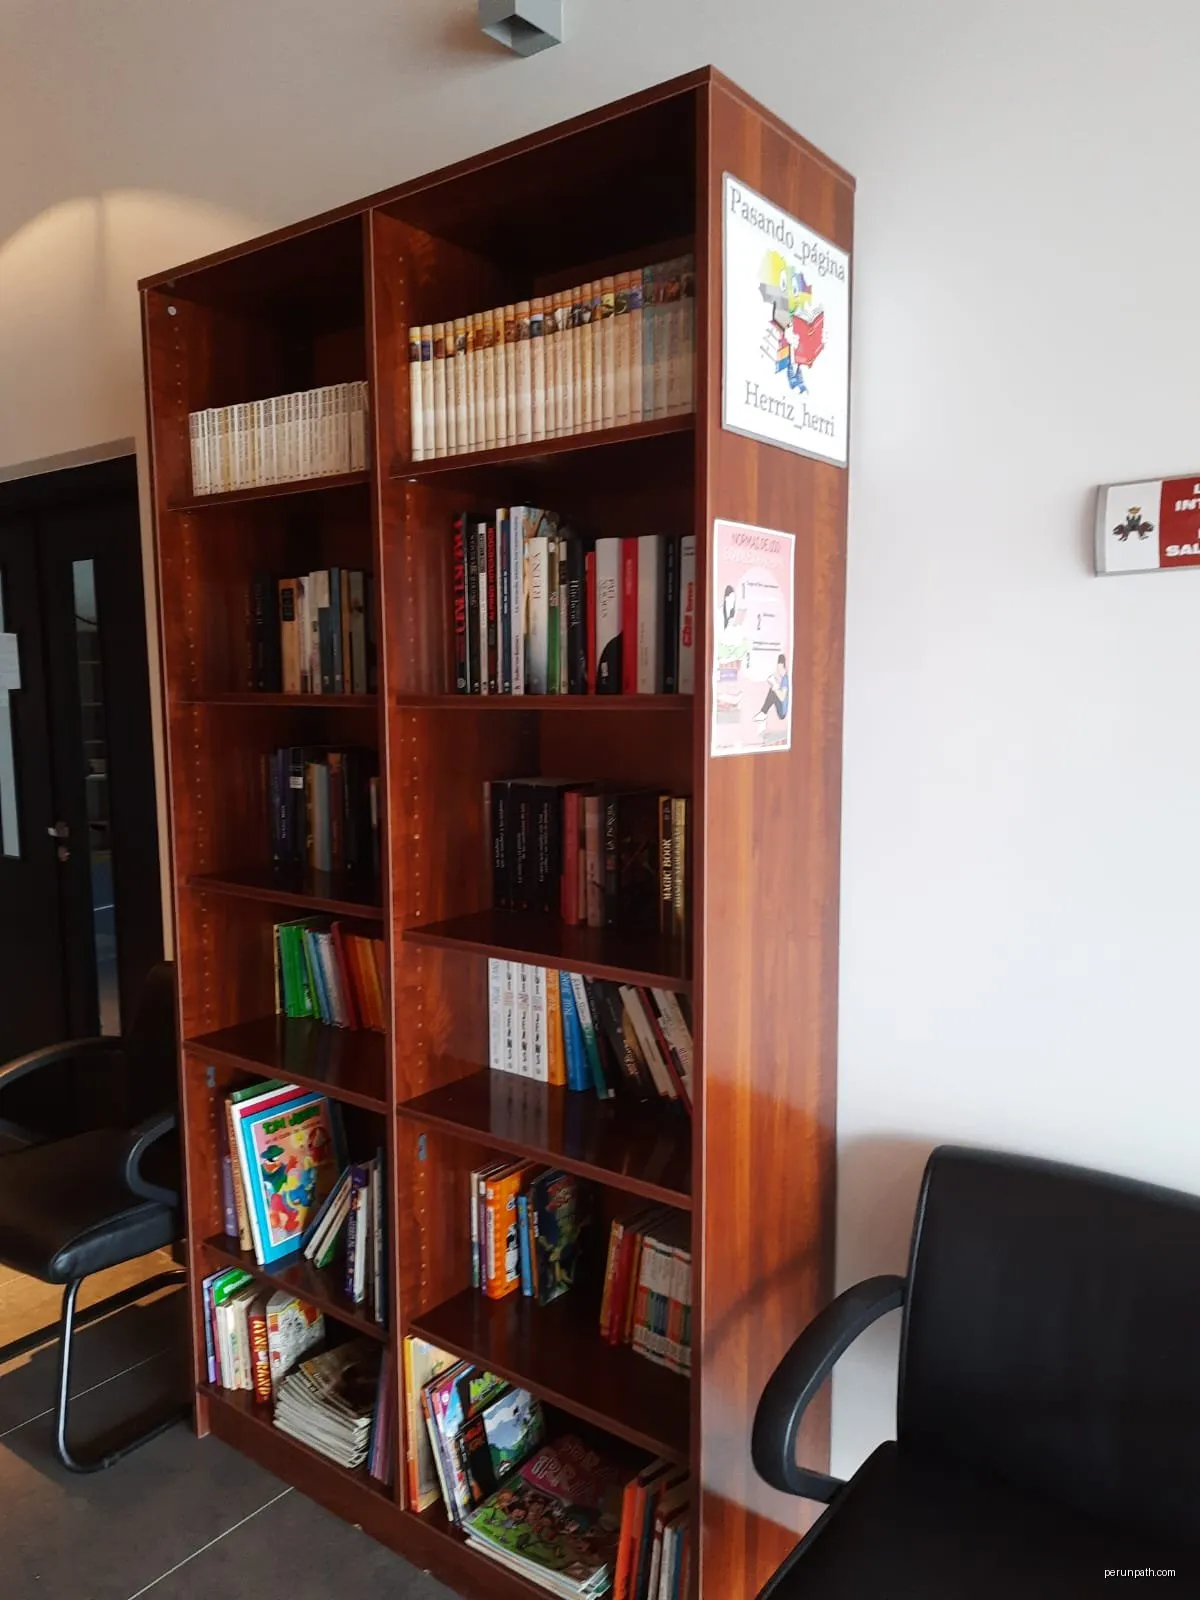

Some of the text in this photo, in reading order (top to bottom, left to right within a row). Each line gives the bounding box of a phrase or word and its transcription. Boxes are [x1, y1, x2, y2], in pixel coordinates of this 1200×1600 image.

[663, 839, 672, 900] MAGIC BOOK
[255, 1361, 271, 1395] RAND
